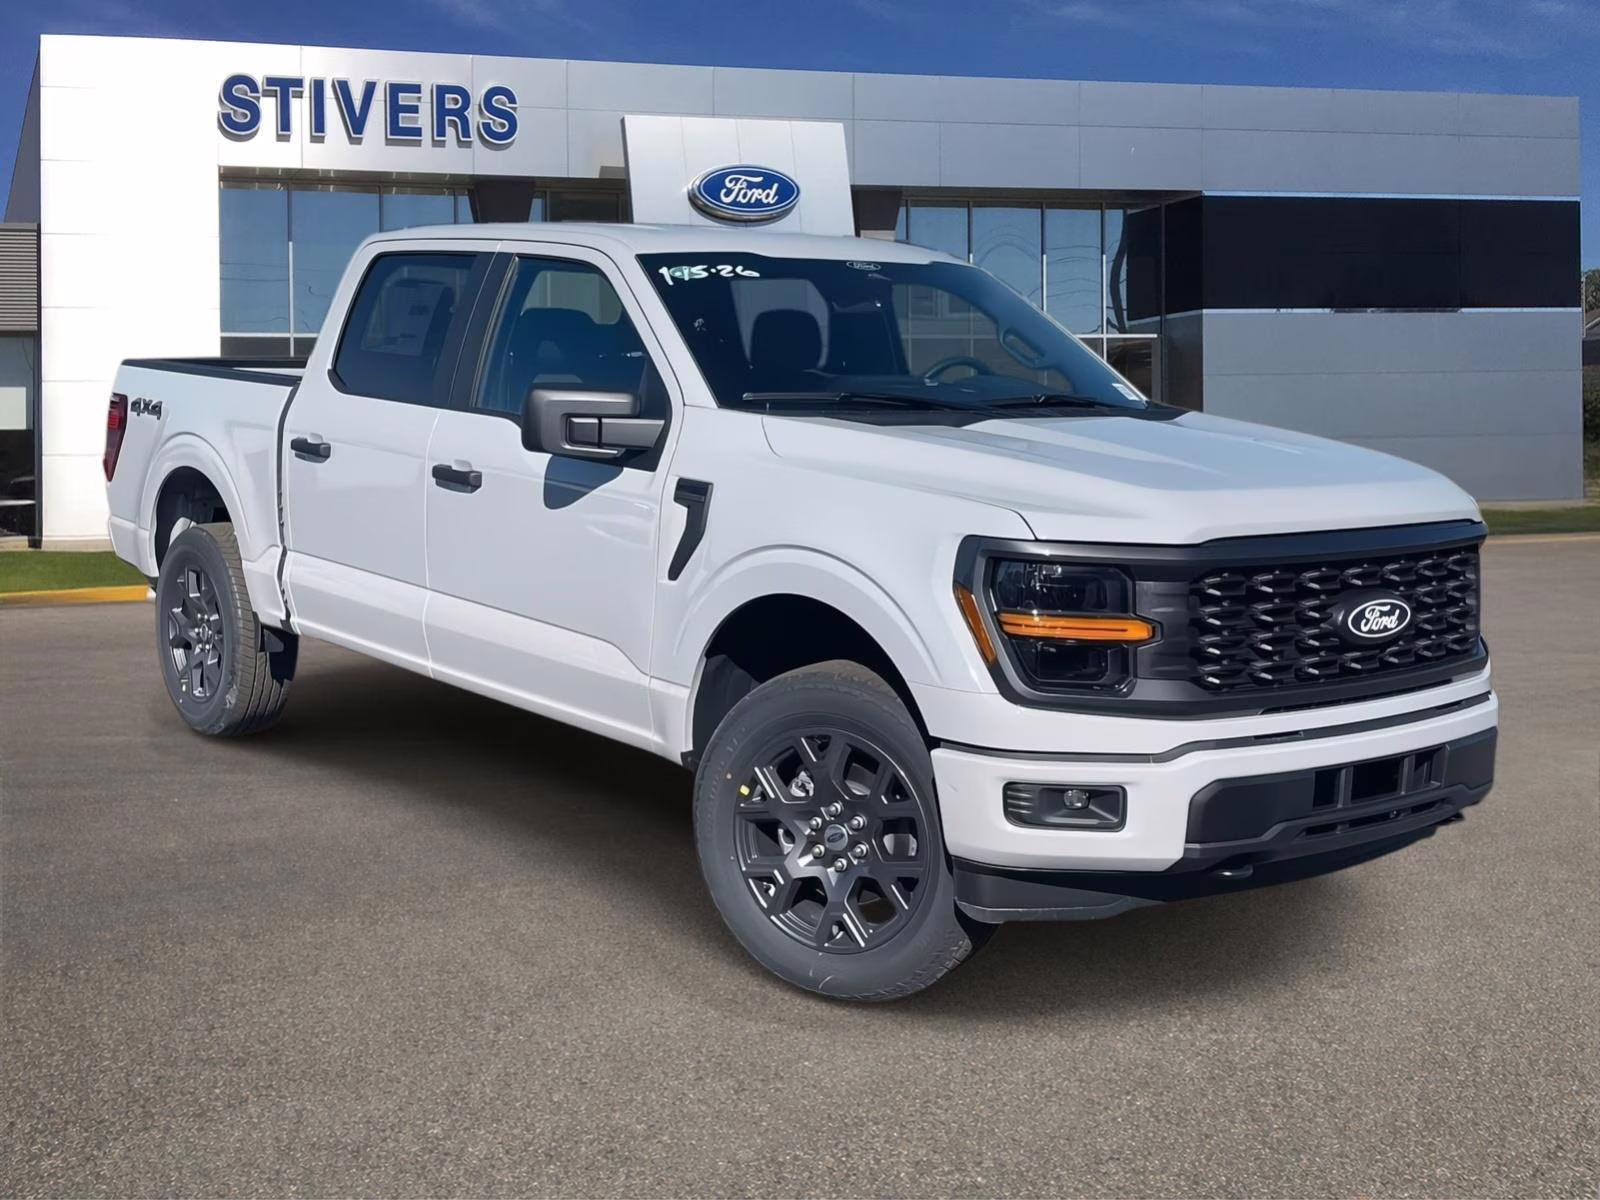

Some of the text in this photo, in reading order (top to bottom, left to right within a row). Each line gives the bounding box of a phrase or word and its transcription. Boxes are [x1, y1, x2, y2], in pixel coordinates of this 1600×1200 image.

[218, 73, 519, 147] STIVERS
[719, 174, 779, 204] Ford
[1360, 604, 1400, 632] Ford
